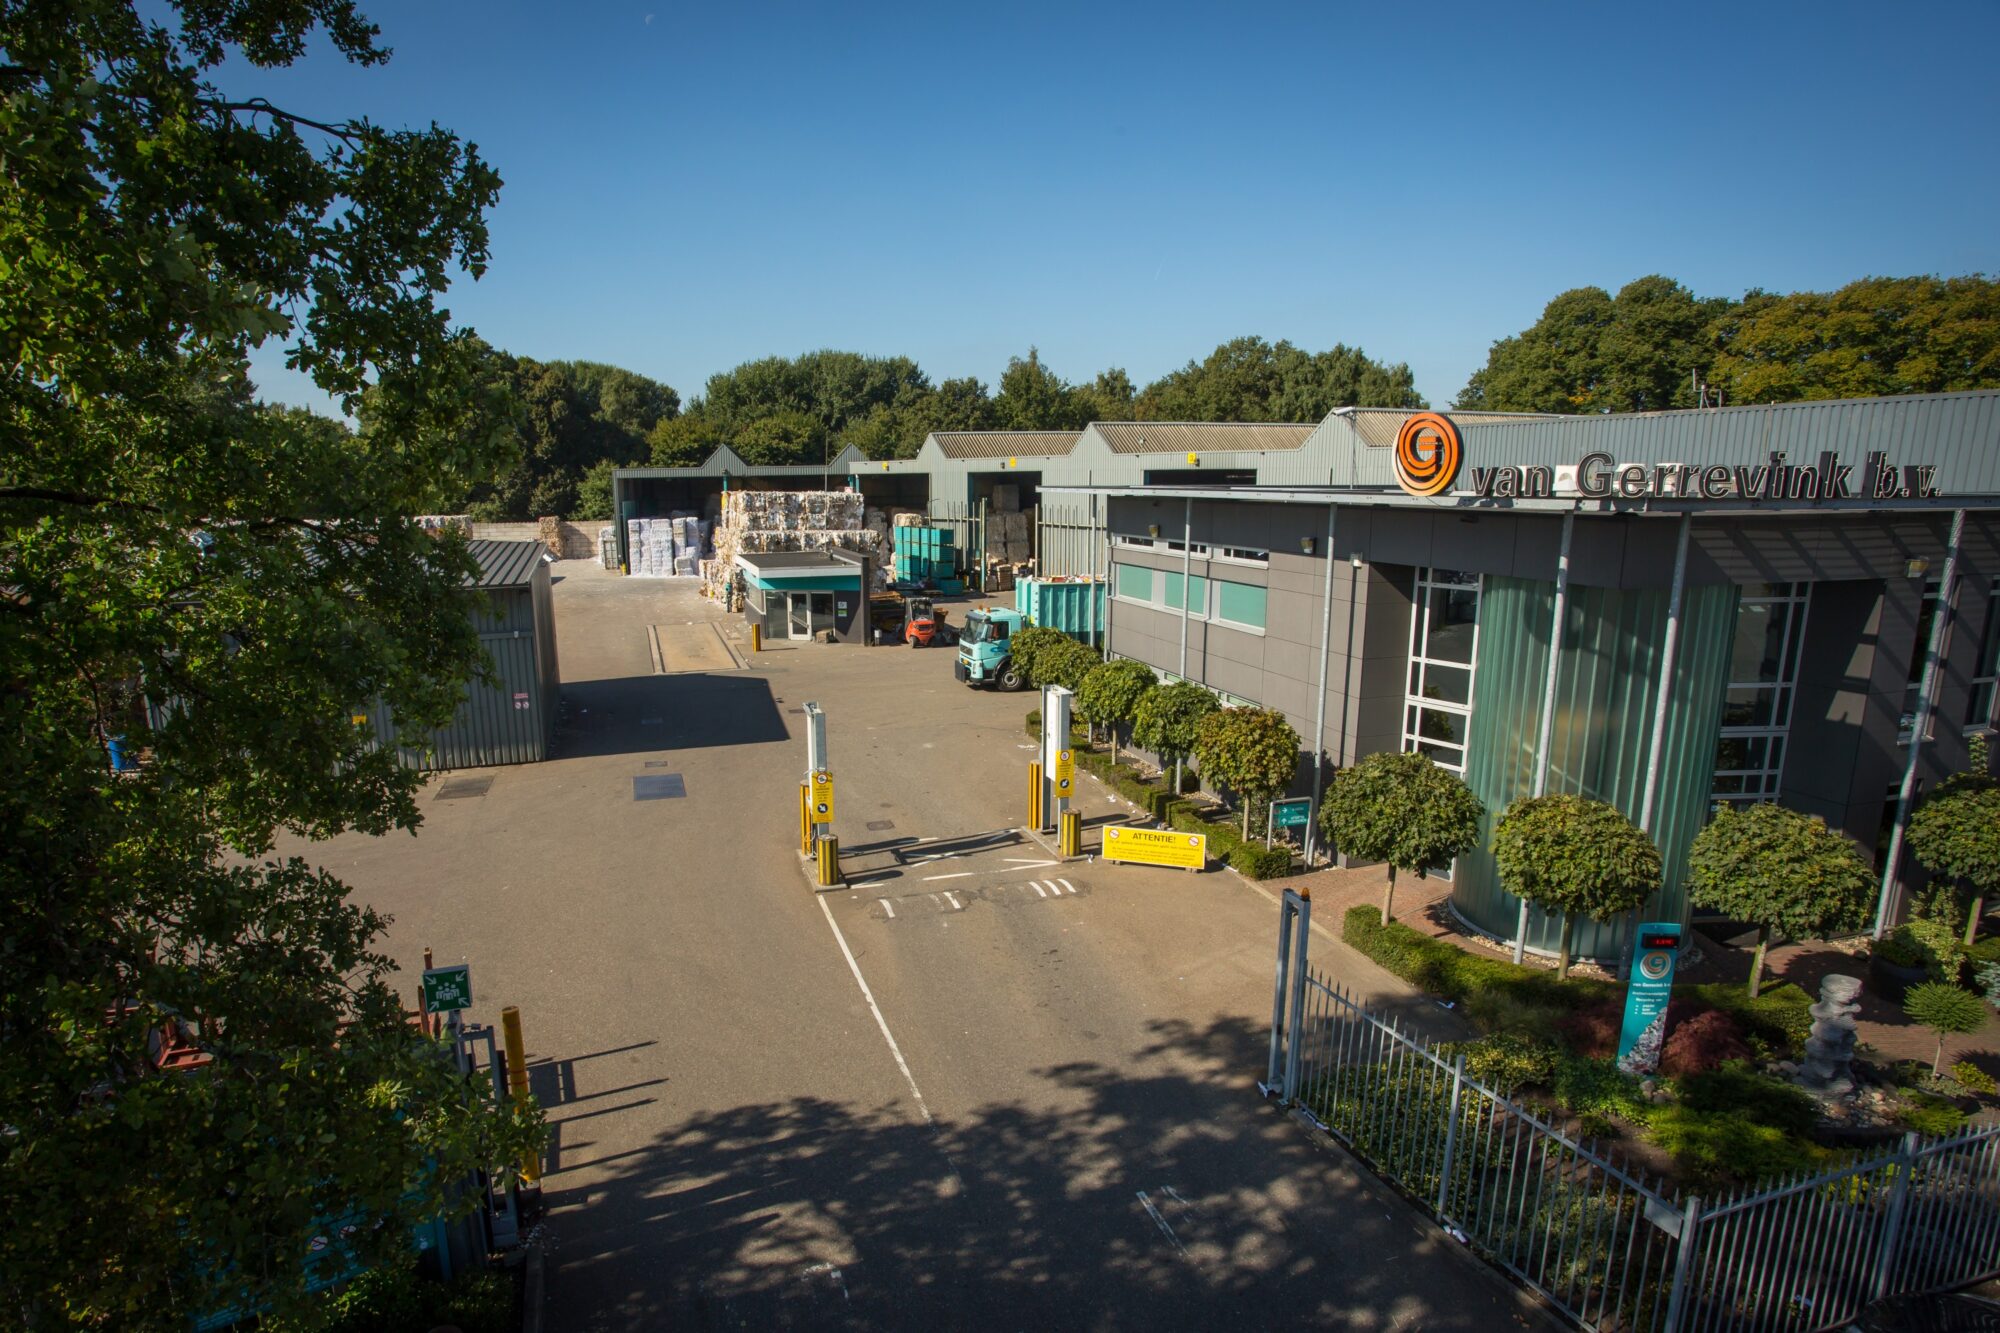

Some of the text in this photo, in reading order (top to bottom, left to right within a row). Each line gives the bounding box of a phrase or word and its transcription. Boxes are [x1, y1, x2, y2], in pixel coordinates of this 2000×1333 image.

[1471, 450, 1942, 498] van Gerrevink b.v.
[1132, 832, 1176, 843] ATTENTIE!
